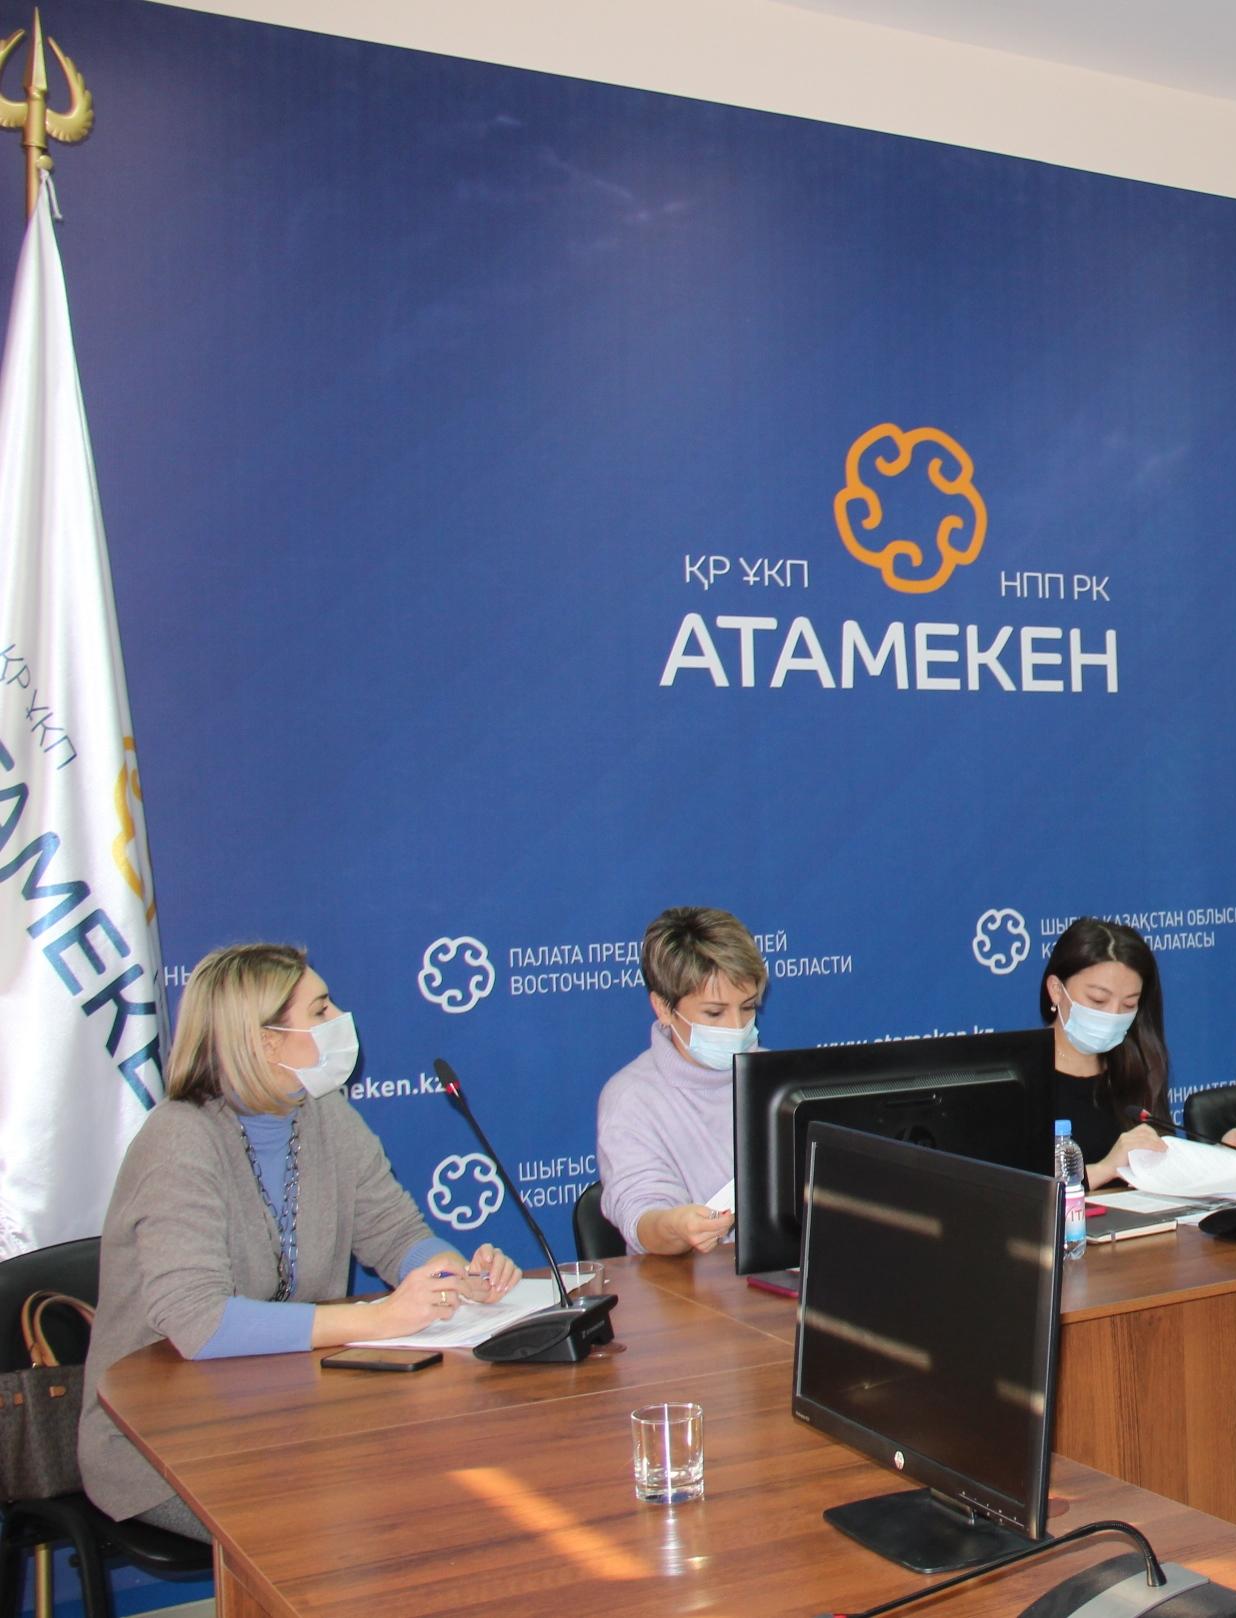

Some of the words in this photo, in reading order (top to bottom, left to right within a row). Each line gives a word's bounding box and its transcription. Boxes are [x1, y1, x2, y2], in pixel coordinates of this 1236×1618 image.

[684, 555, 730, 590] ҚР
[739, 557, 809, 588] ҰКП
[1001, 571, 1065, 599] НПП
[1073, 575, 1111, 602] РК
[659, 612, 1119, 693] АТАМЕКЕН
[509, 944, 584, 968] ПАЛАТА
[775, 955, 853, 978] ОБЛАСТИ
[518, 1154, 597, 1181] ШЫҒЫС
